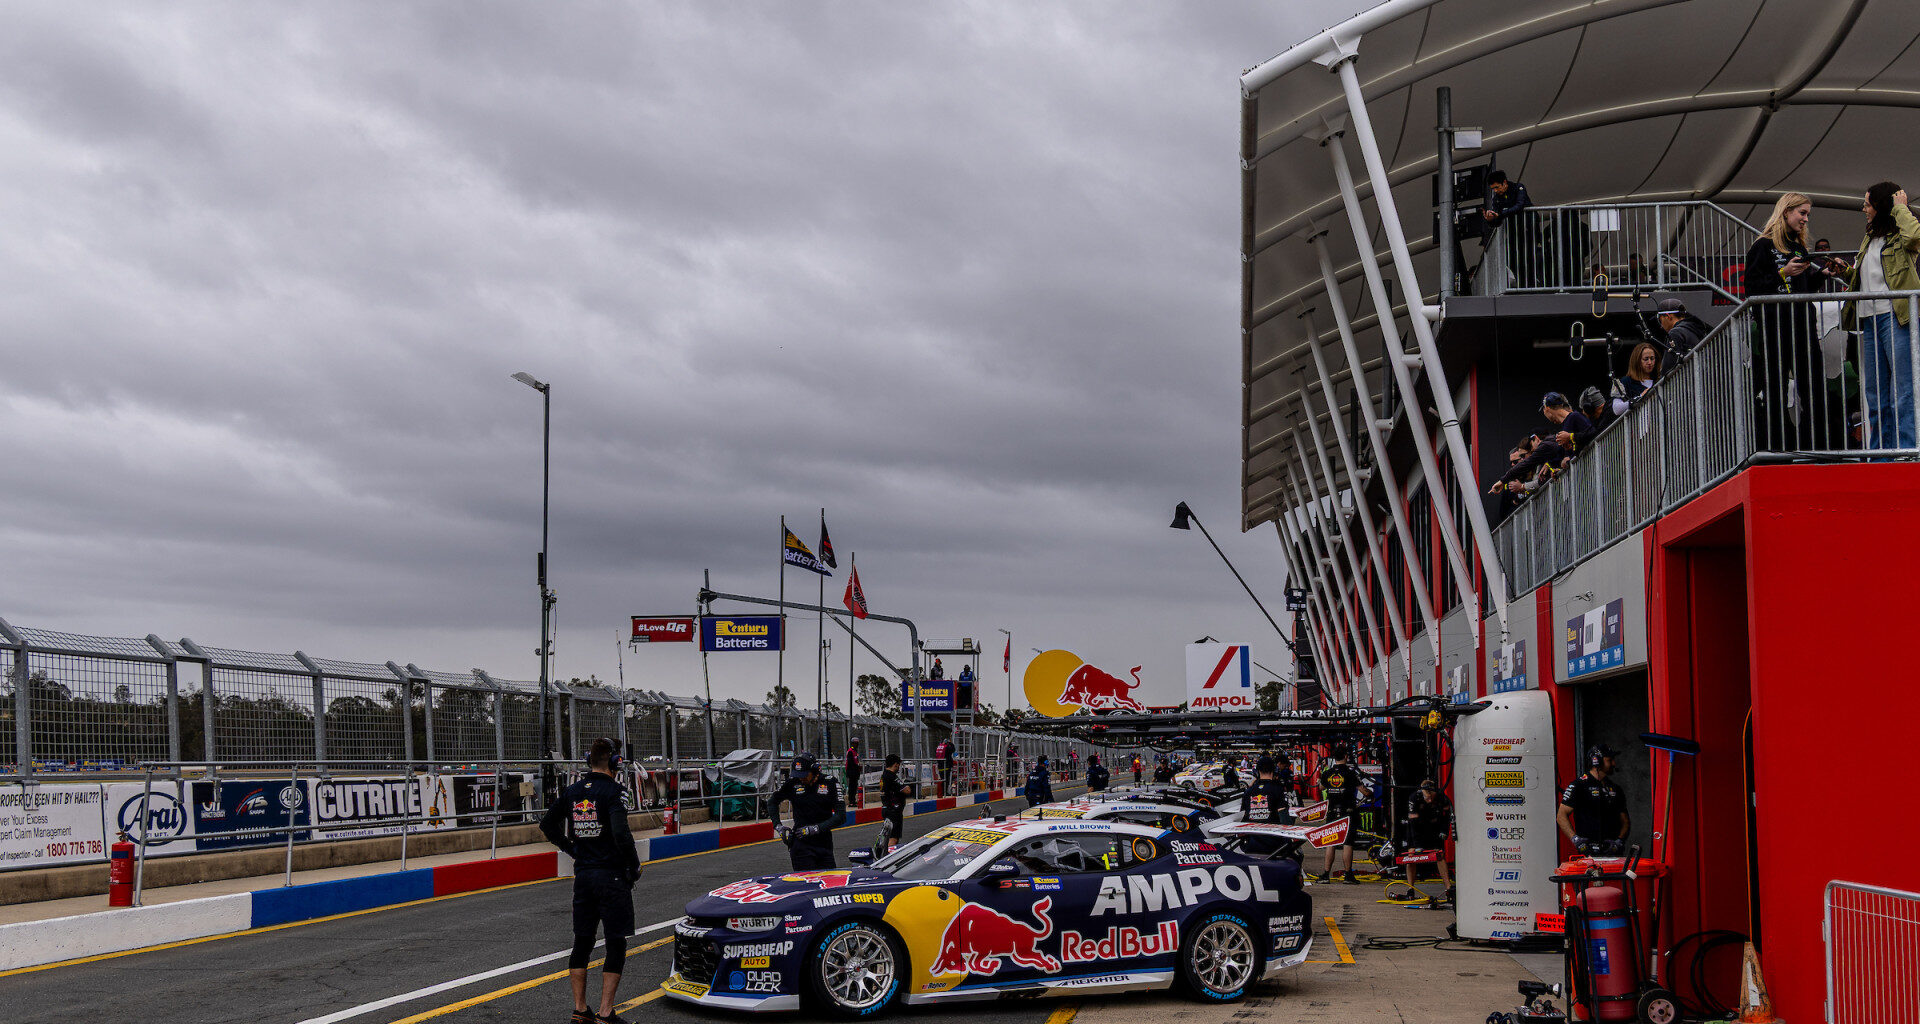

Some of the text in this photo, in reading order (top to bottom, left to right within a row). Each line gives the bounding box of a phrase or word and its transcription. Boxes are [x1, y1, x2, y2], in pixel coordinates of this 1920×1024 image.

[716, 621, 768, 636] Century
[716, 637, 768, 648] Batteries
[908, 698, 948, 707] Btteries
[1191, 696, 1251, 707] AMPOL
[52, 792, 64, 805] HIT
[65, 792, 75, 804] BY
[317, 782, 421, 818] CUTRITE
[11, 815, 25, 825] Your
[26, 814, 49, 824] Excess
[124, 798, 180, 832] Arai
[574, 821, 603, 829] AMPOL
[14, 828, 33, 839] Claim
[34, 826, 72, 839] Management
[575, 829, 601, 837] RACING
[1310, 822, 1348, 842] SUPERCHEAP
[1323, 834, 1338, 843] AUTO
[6, 851, 31, 860] Inspection
[35, 849, 44, 857] Call
[47, 842, 68, 857] 1800
[70, 841, 86, 855] 776
[87, 840, 104, 854] 786
[1170, 840, 1217, 852] Shaw and
[1102, 853, 1111, 871] 1
[1174, 852, 1224, 864] Partners
[1496, 871, 1519, 880] JGI
[1090, 864, 1280, 917] AMPOL
[813, 893, 885, 908] MAKE IT SUPER
[785, 914, 803, 923] Shaw
[1210, 914, 1249, 928] DUNLOP
[786, 925, 813, 934] Partners
[819, 921, 860, 953] DUNLOP
[1274, 935, 1301, 950] JGI
[723, 941, 794, 959] SUPERCHEAP
[743, 958, 767, 966] AUTO
[747, 971, 782, 982] QUAD
[746, 981, 782, 993] LOCK
